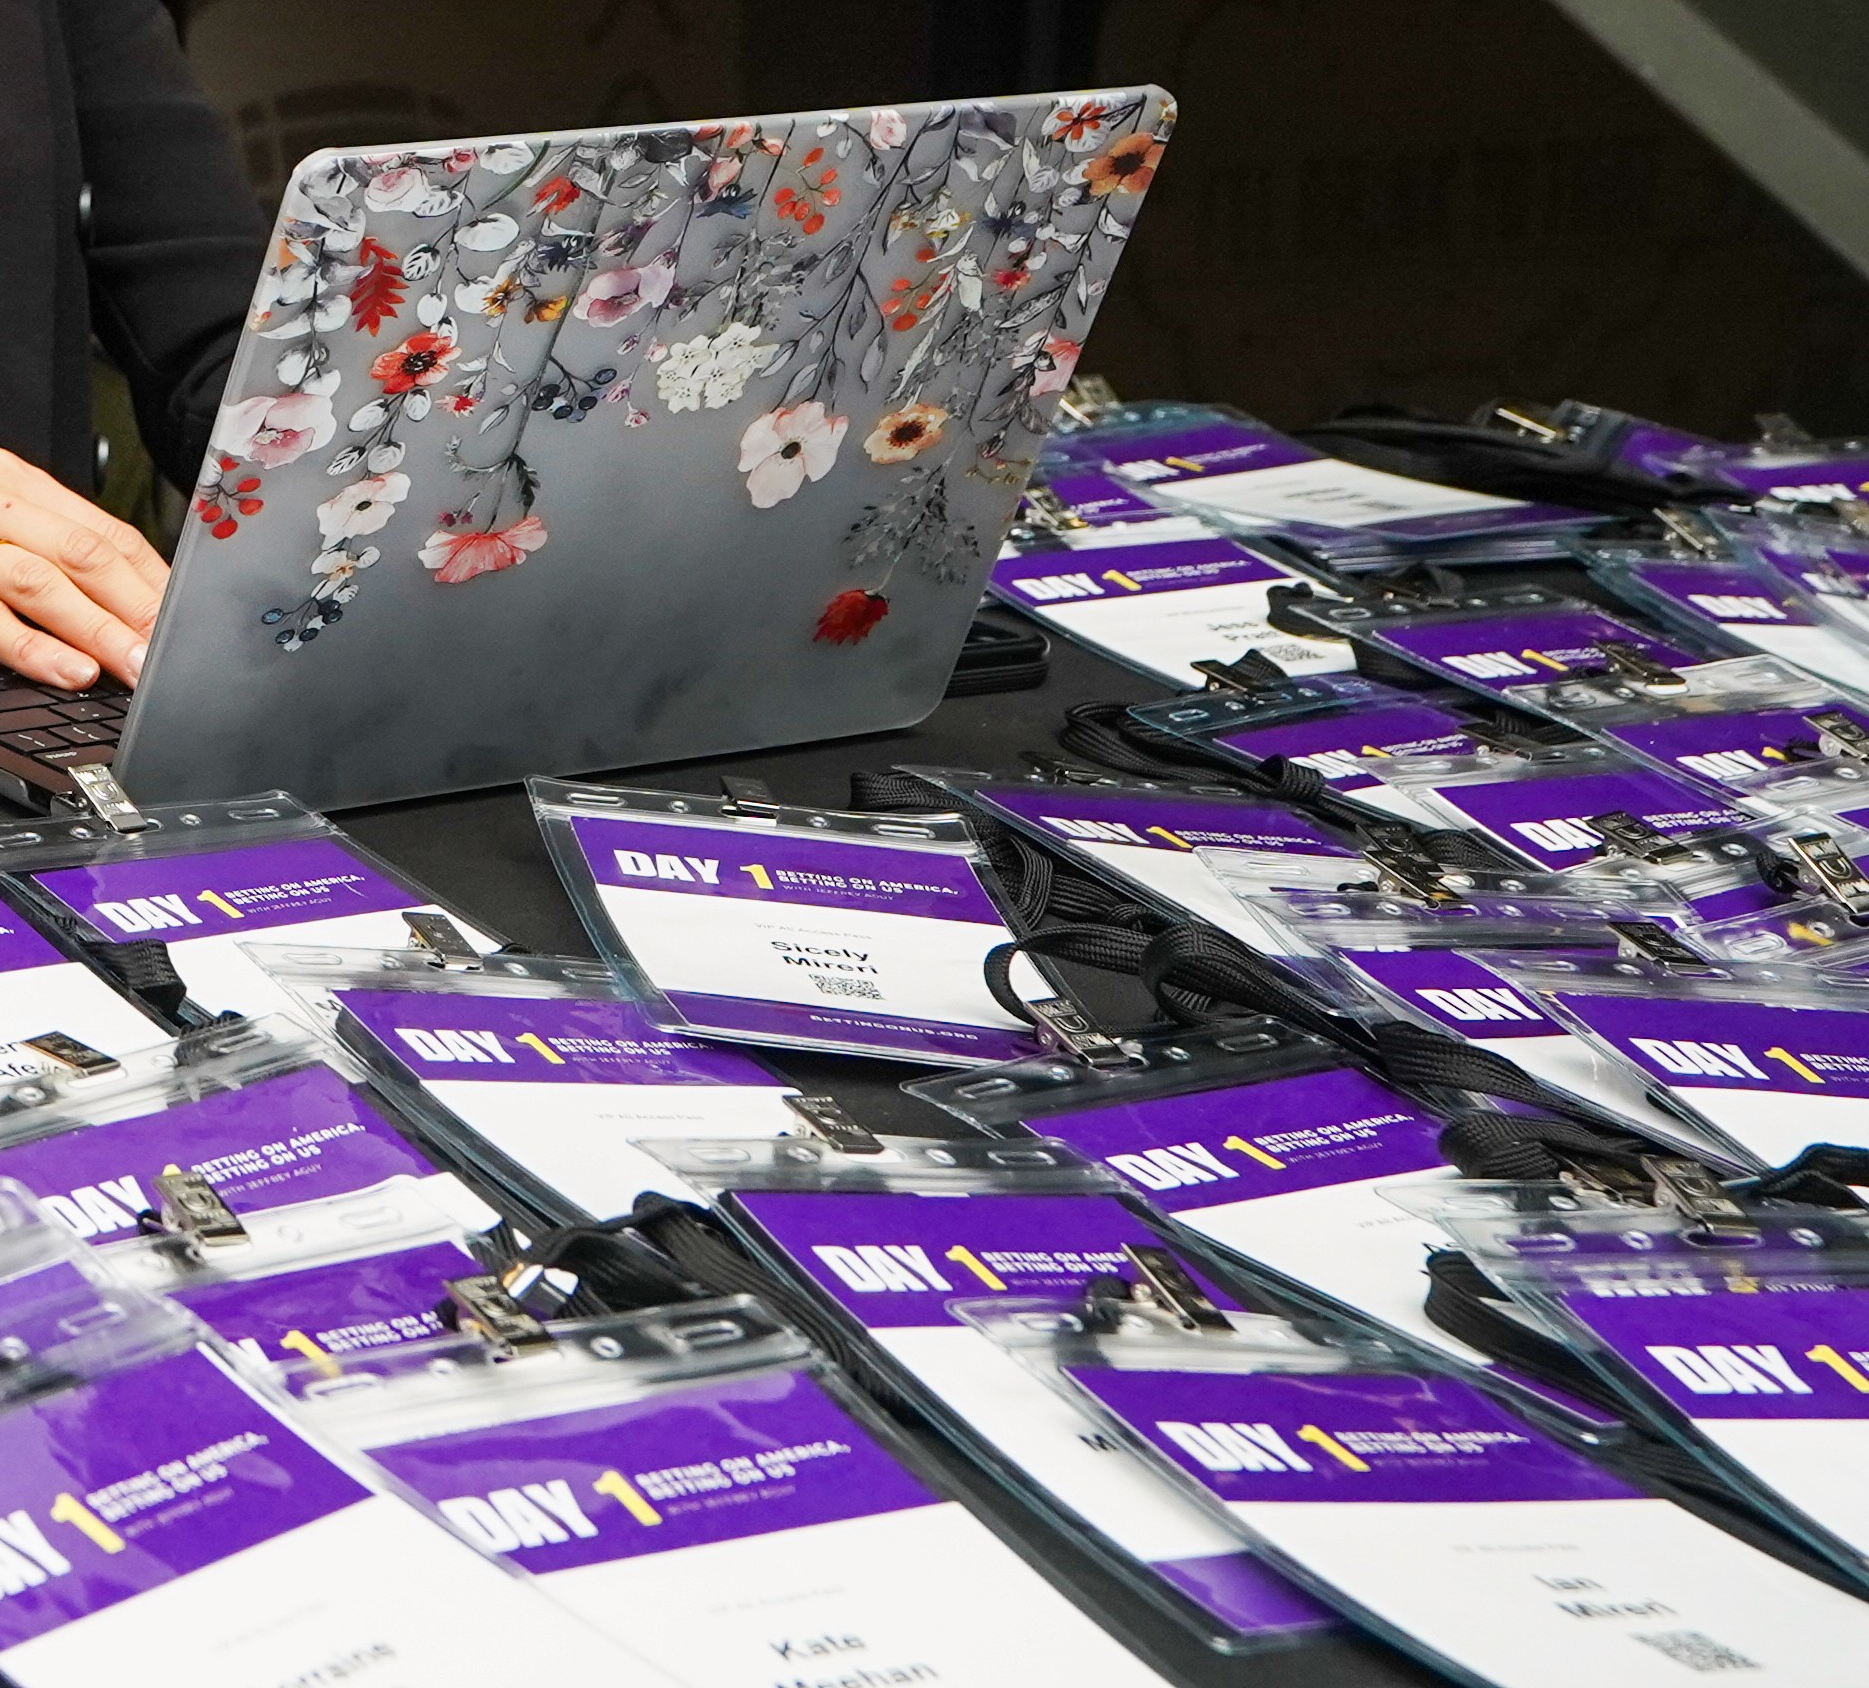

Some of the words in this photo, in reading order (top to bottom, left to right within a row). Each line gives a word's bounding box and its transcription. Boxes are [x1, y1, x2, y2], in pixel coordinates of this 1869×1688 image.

[1012, 573, 1105, 600] DAY
[1102, 570, 1142, 591] 1
[1687, 594, 1788, 620] DAY
[1441, 651, 1537, 679] DAY
[1521, 649, 1569, 672] 1
[1676, 750, 1769, 780] DAY
[1039, 816, 1150, 844] DAY
[1146, 826, 1193, 849] 1
[613, 849, 720, 885] DAY
[740, 863, 774, 890] 1
[775, 869, 845, 884] BETTING
[850, 874, 874, 885] ON
[878, 878, 959, 895] AMERICA,
[778, 875, 848, 889] BETTING
[852, 880, 878, 892] ON
[882, 885, 903, 895] US
[224, 883, 279, 900] BETTING
[283, 880, 302, 891] ON
[304, 874, 366, 889] AMERICA,
[94, 894, 203, 933] DAY
[196, 890, 245, 919] 1
[771, 940, 870, 963] Sicely
[782, 955, 879, 975] Mireri
[1415, 988, 1543, 1021] DAY
[809, 1014, 980, 1041] BETTINGONUS.ORG
[394, 1028, 515, 1064] DAY
[515, 1033, 565, 1065] 1
[1629, 1038, 1770, 1081] DAY
[1764, 1047, 1825, 1084] 1
[1253, 1129, 1314, 1146] BETTING
[1317, 1124, 1342, 1136] ON
[1344, 1113, 1414, 1131] AMERICA,
[1263, 1137, 1326, 1153] BETTING
[1329, 1132, 1352, 1144] ON
[1354, 1127, 1377, 1139] US
[191, 1148, 260, 1173] BETTING
[261, 1141, 288, 1157] ON
[290, 1122, 366, 1148] AMERICA,
[204, 1159, 268, 1184] BETTING
[271, 1151, 296, 1166] ON
[298, 1144, 322, 1160] US
[1106, 1142, 1239, 1190] DAY
[1223, 1136, 1286, 1169] 1
[39, 1175, 153, 1238] DAY
[812, 1245, 953, 1292] DAY
[945, 1245, 1008, 1291] 1
[981, 1251, 1052, 1264] BETTING
[1054, 1251, 1079, 1264] ON
[280, 1330, 341, 1377] 1
[1645, 1345, 1813, 1394] DAY
[1155, 1421, 1314, 1472] DAY
[1297, 1424, 1371, 1472] 1
[50, 1492, 126, 1554] 1
[438, 1479, 599, 1553] DAY
[593, 1470, 663, 1526] 1
[770, 1633, 866, 1662] Kate
